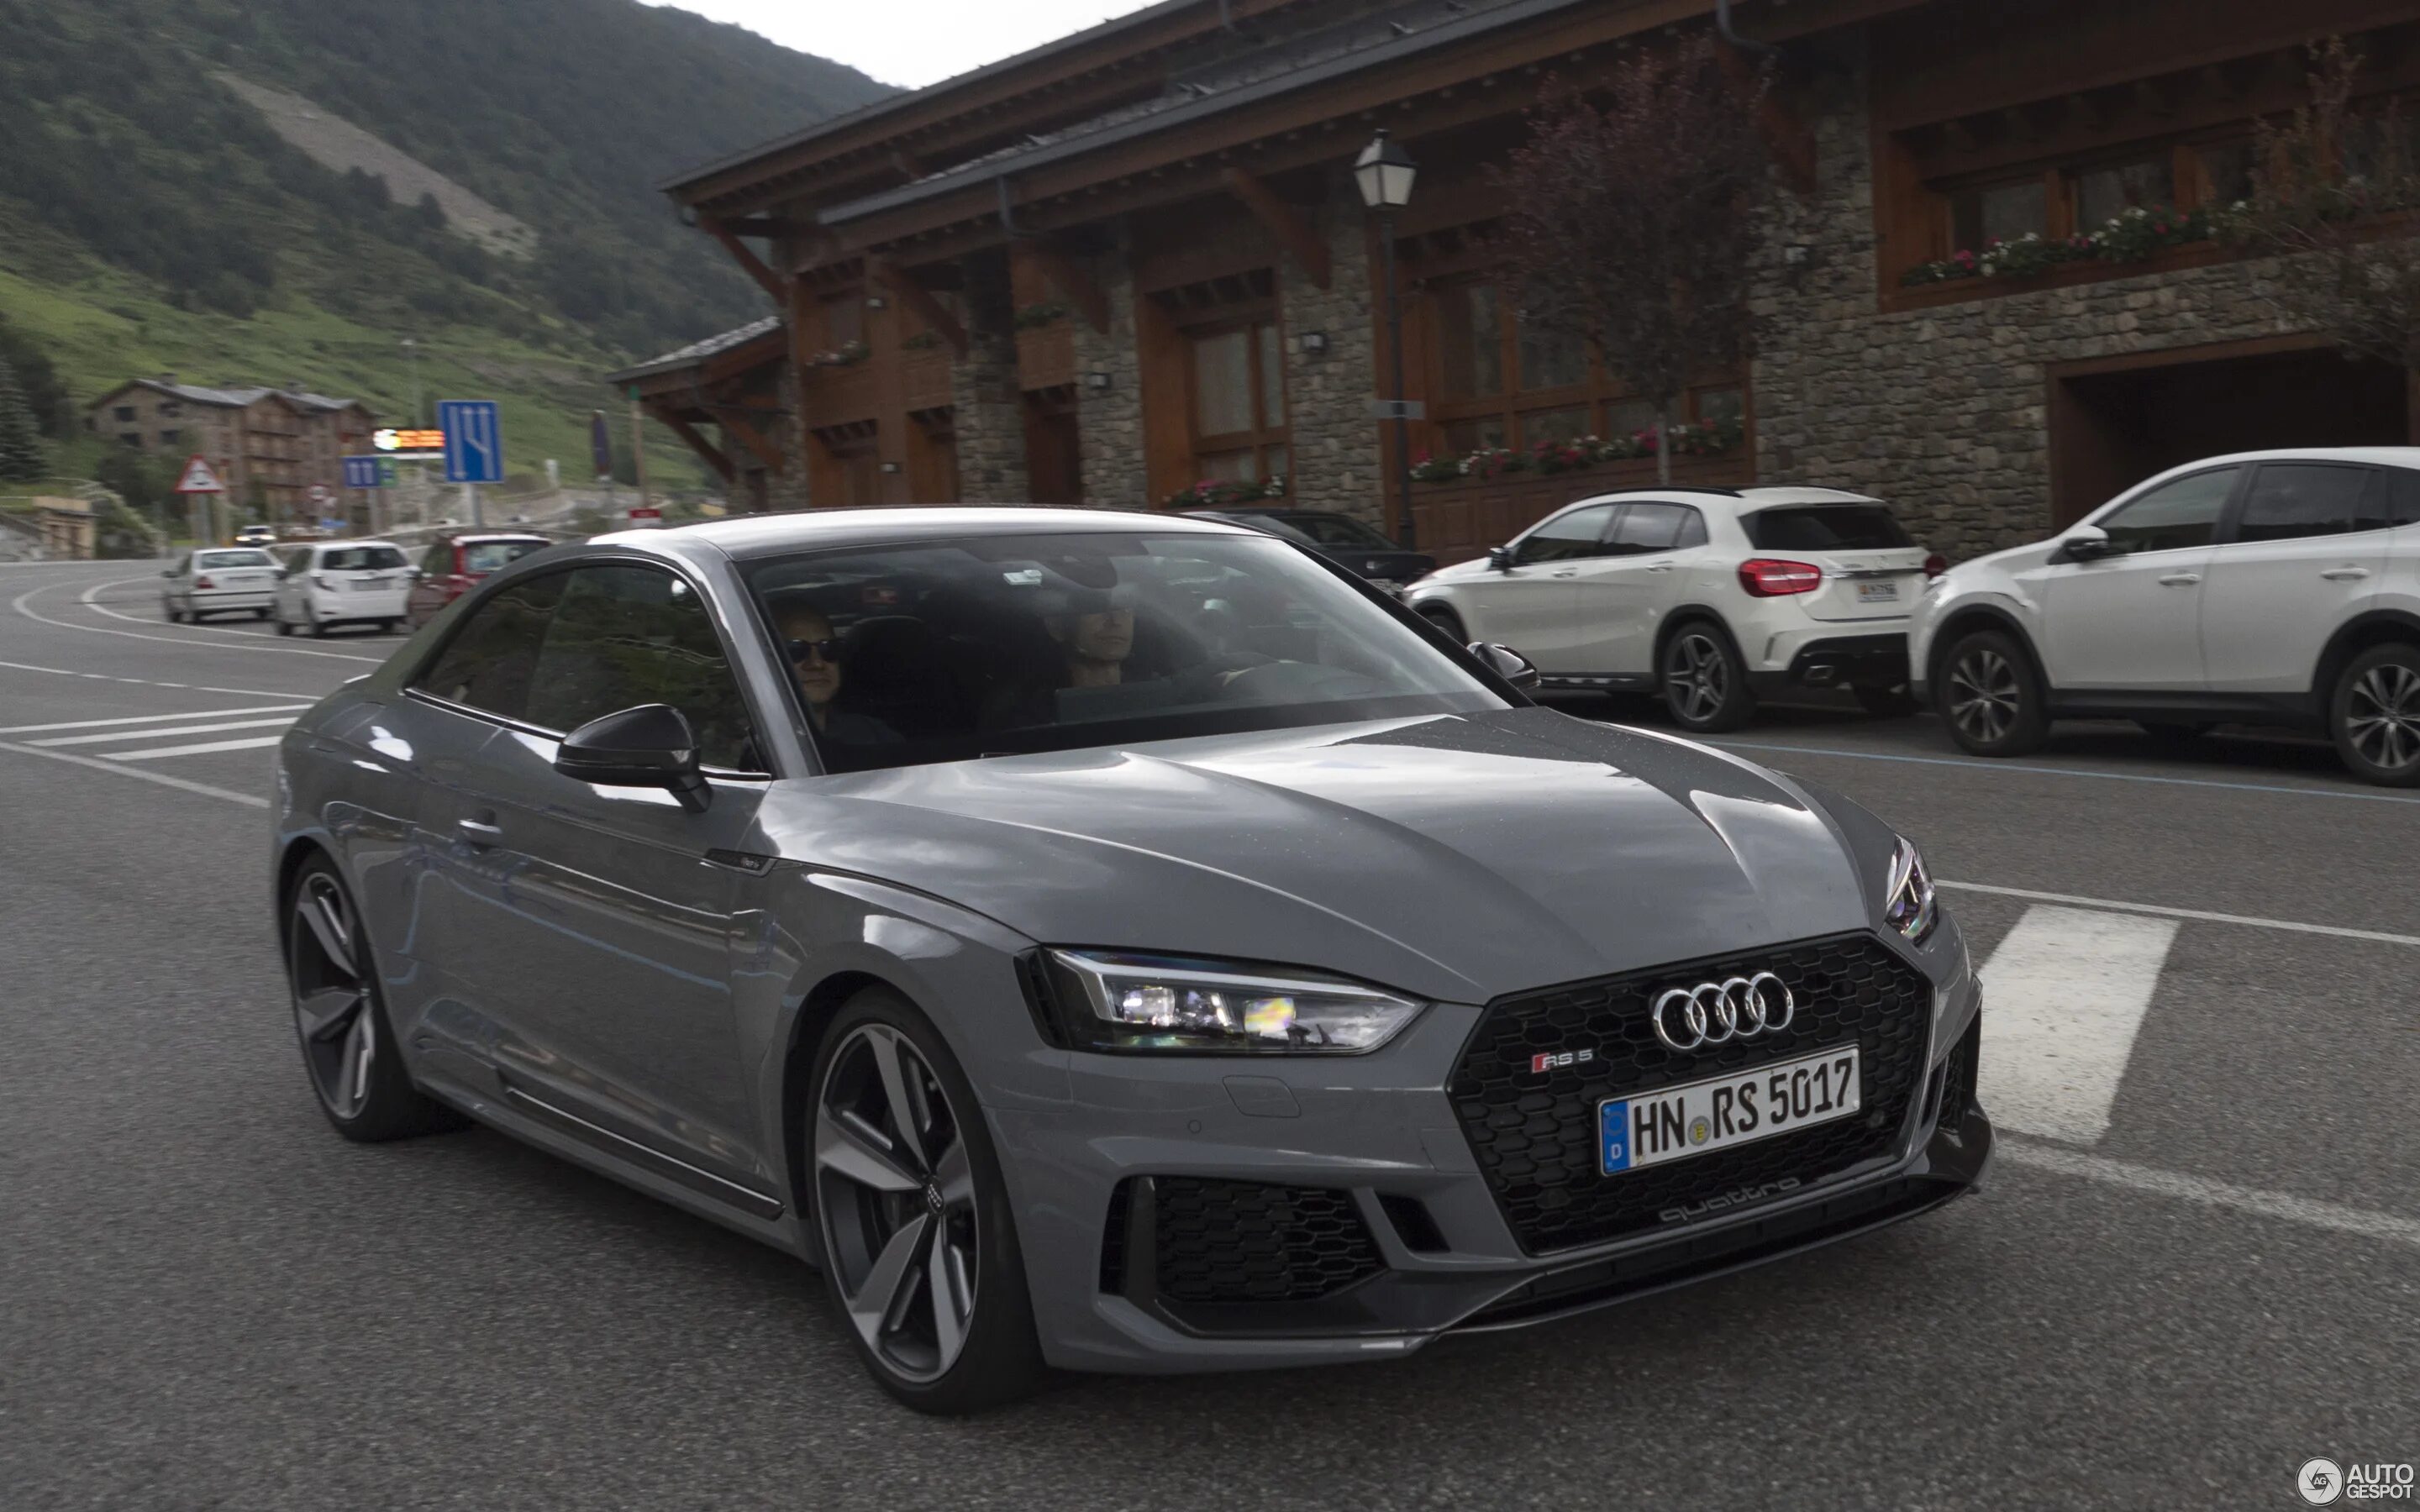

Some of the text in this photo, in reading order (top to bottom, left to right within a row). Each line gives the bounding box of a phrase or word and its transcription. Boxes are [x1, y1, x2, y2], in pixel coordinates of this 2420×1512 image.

[1542, 1048, 1593, 1069] RS 5
[1634, 1058, 1853, 1157] HN RS 5017
[1611, 1143, 1623, 1159] D
[1659, 1177, 1801, 1221] quattro
